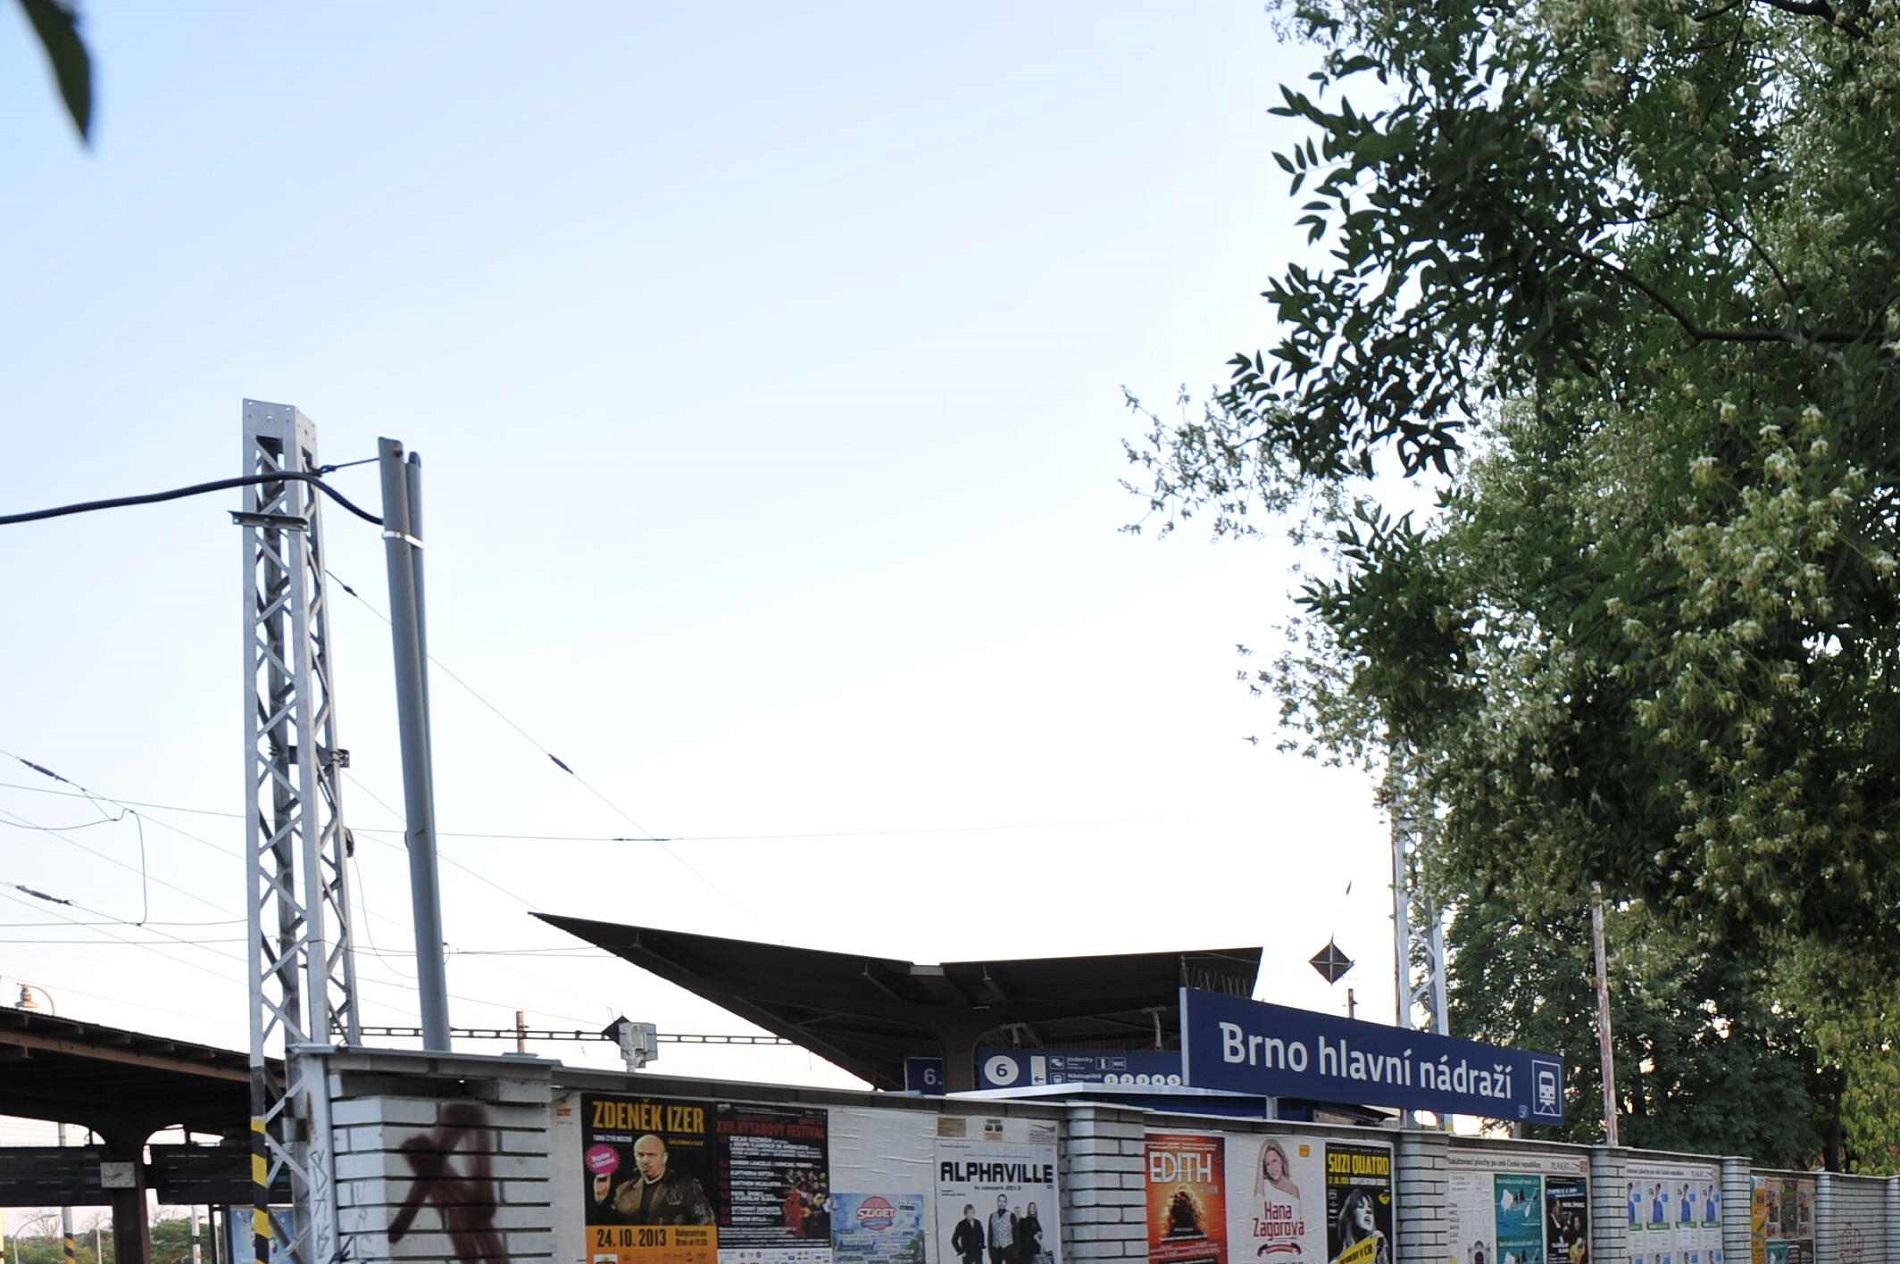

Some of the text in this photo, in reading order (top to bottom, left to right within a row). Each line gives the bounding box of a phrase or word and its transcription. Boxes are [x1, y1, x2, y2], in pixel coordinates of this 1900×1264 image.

[995, 1064, 1007, 1078] 6
[1219, 1021, 1512, 1100] Brno hlavní nádraží
[923, 1068, 943, 1086] 6.
[592, 1099, 705, 1133] ZDENĚK IZER
[941, 1161, 1053, 1183] ALPHAVILLE
[1150, 1152, 1212, 1183] EDITH
[1327, 1153, 1389, 1175] SUZI QUATRO
[857, 1207, 896, 1220] SZIGET
[1264, 1200, 1292, 1220] Hana
[597, 1229, 616, 1247] 24.
[619, 1229, 636, 1247] 10.
[639, 1229, 667, 1247] 2013
[1252, 1217, 1305, 1241] Zagorová
